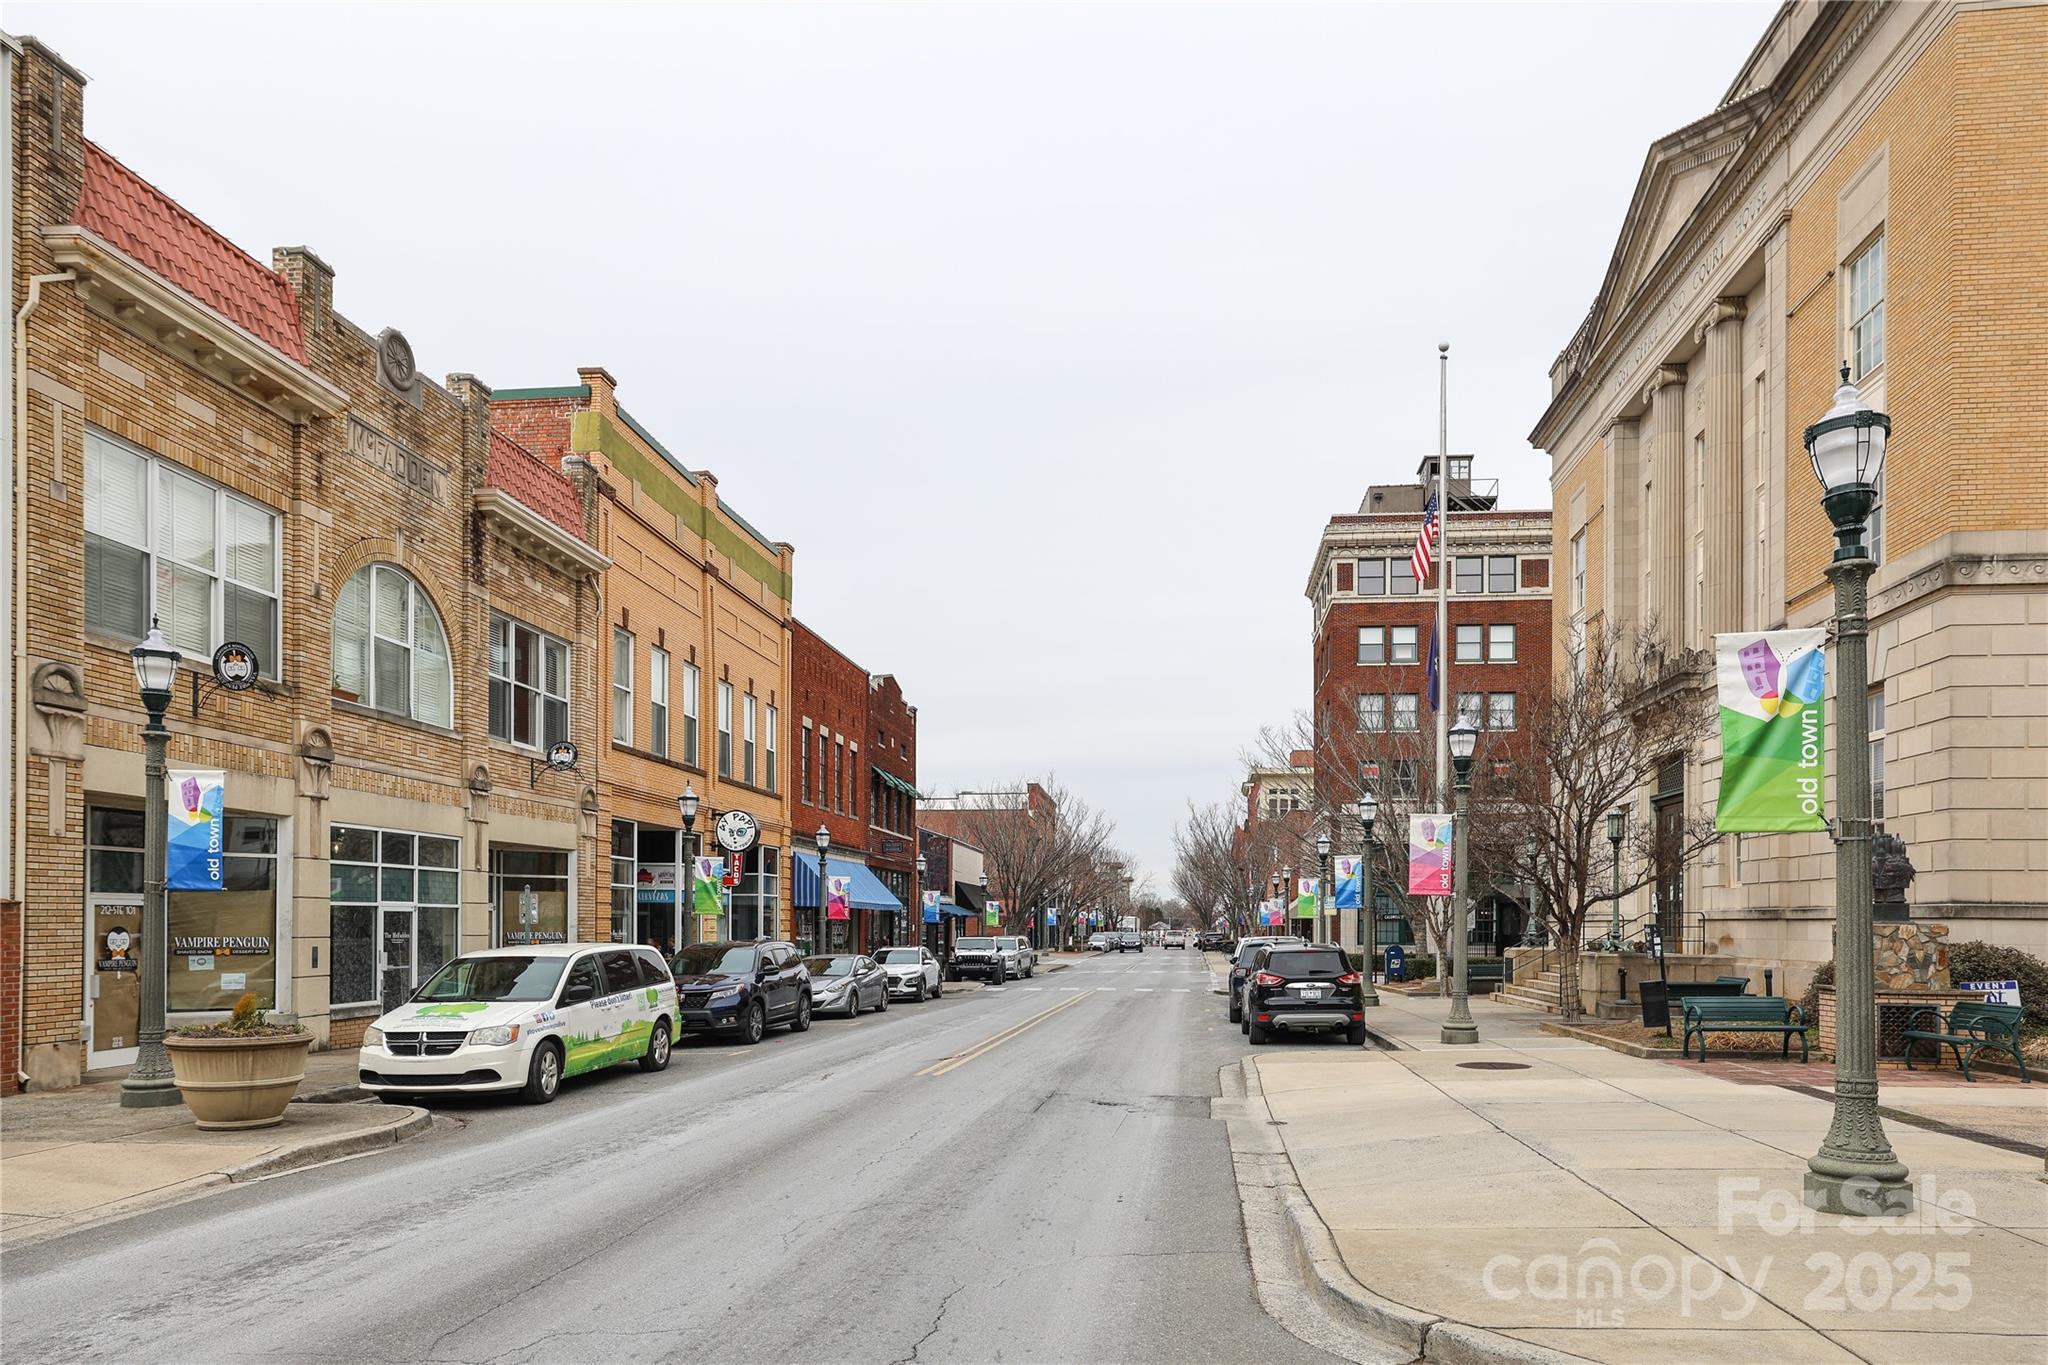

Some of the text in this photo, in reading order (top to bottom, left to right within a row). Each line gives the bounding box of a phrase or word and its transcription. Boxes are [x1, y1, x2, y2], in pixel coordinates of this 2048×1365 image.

[1693, 237, 1725, 290] COURT
[1796, 709, 1818, 815] old town
[732, 812, 754, 830] PAPI
[207, 818, 220, 881] old town
[733, 853, 741, 884] TACOS
[1439, 846, 1449, 889] old town
[125, 905, 136, 915] 101
[174, 936, 270, 948] VAMPIRE PENGUIN
[534, 931, 563, 939] PENGUIN
[1970, 982, 2006, 990] EVENT
[590, 999, 608, 1009] Please
